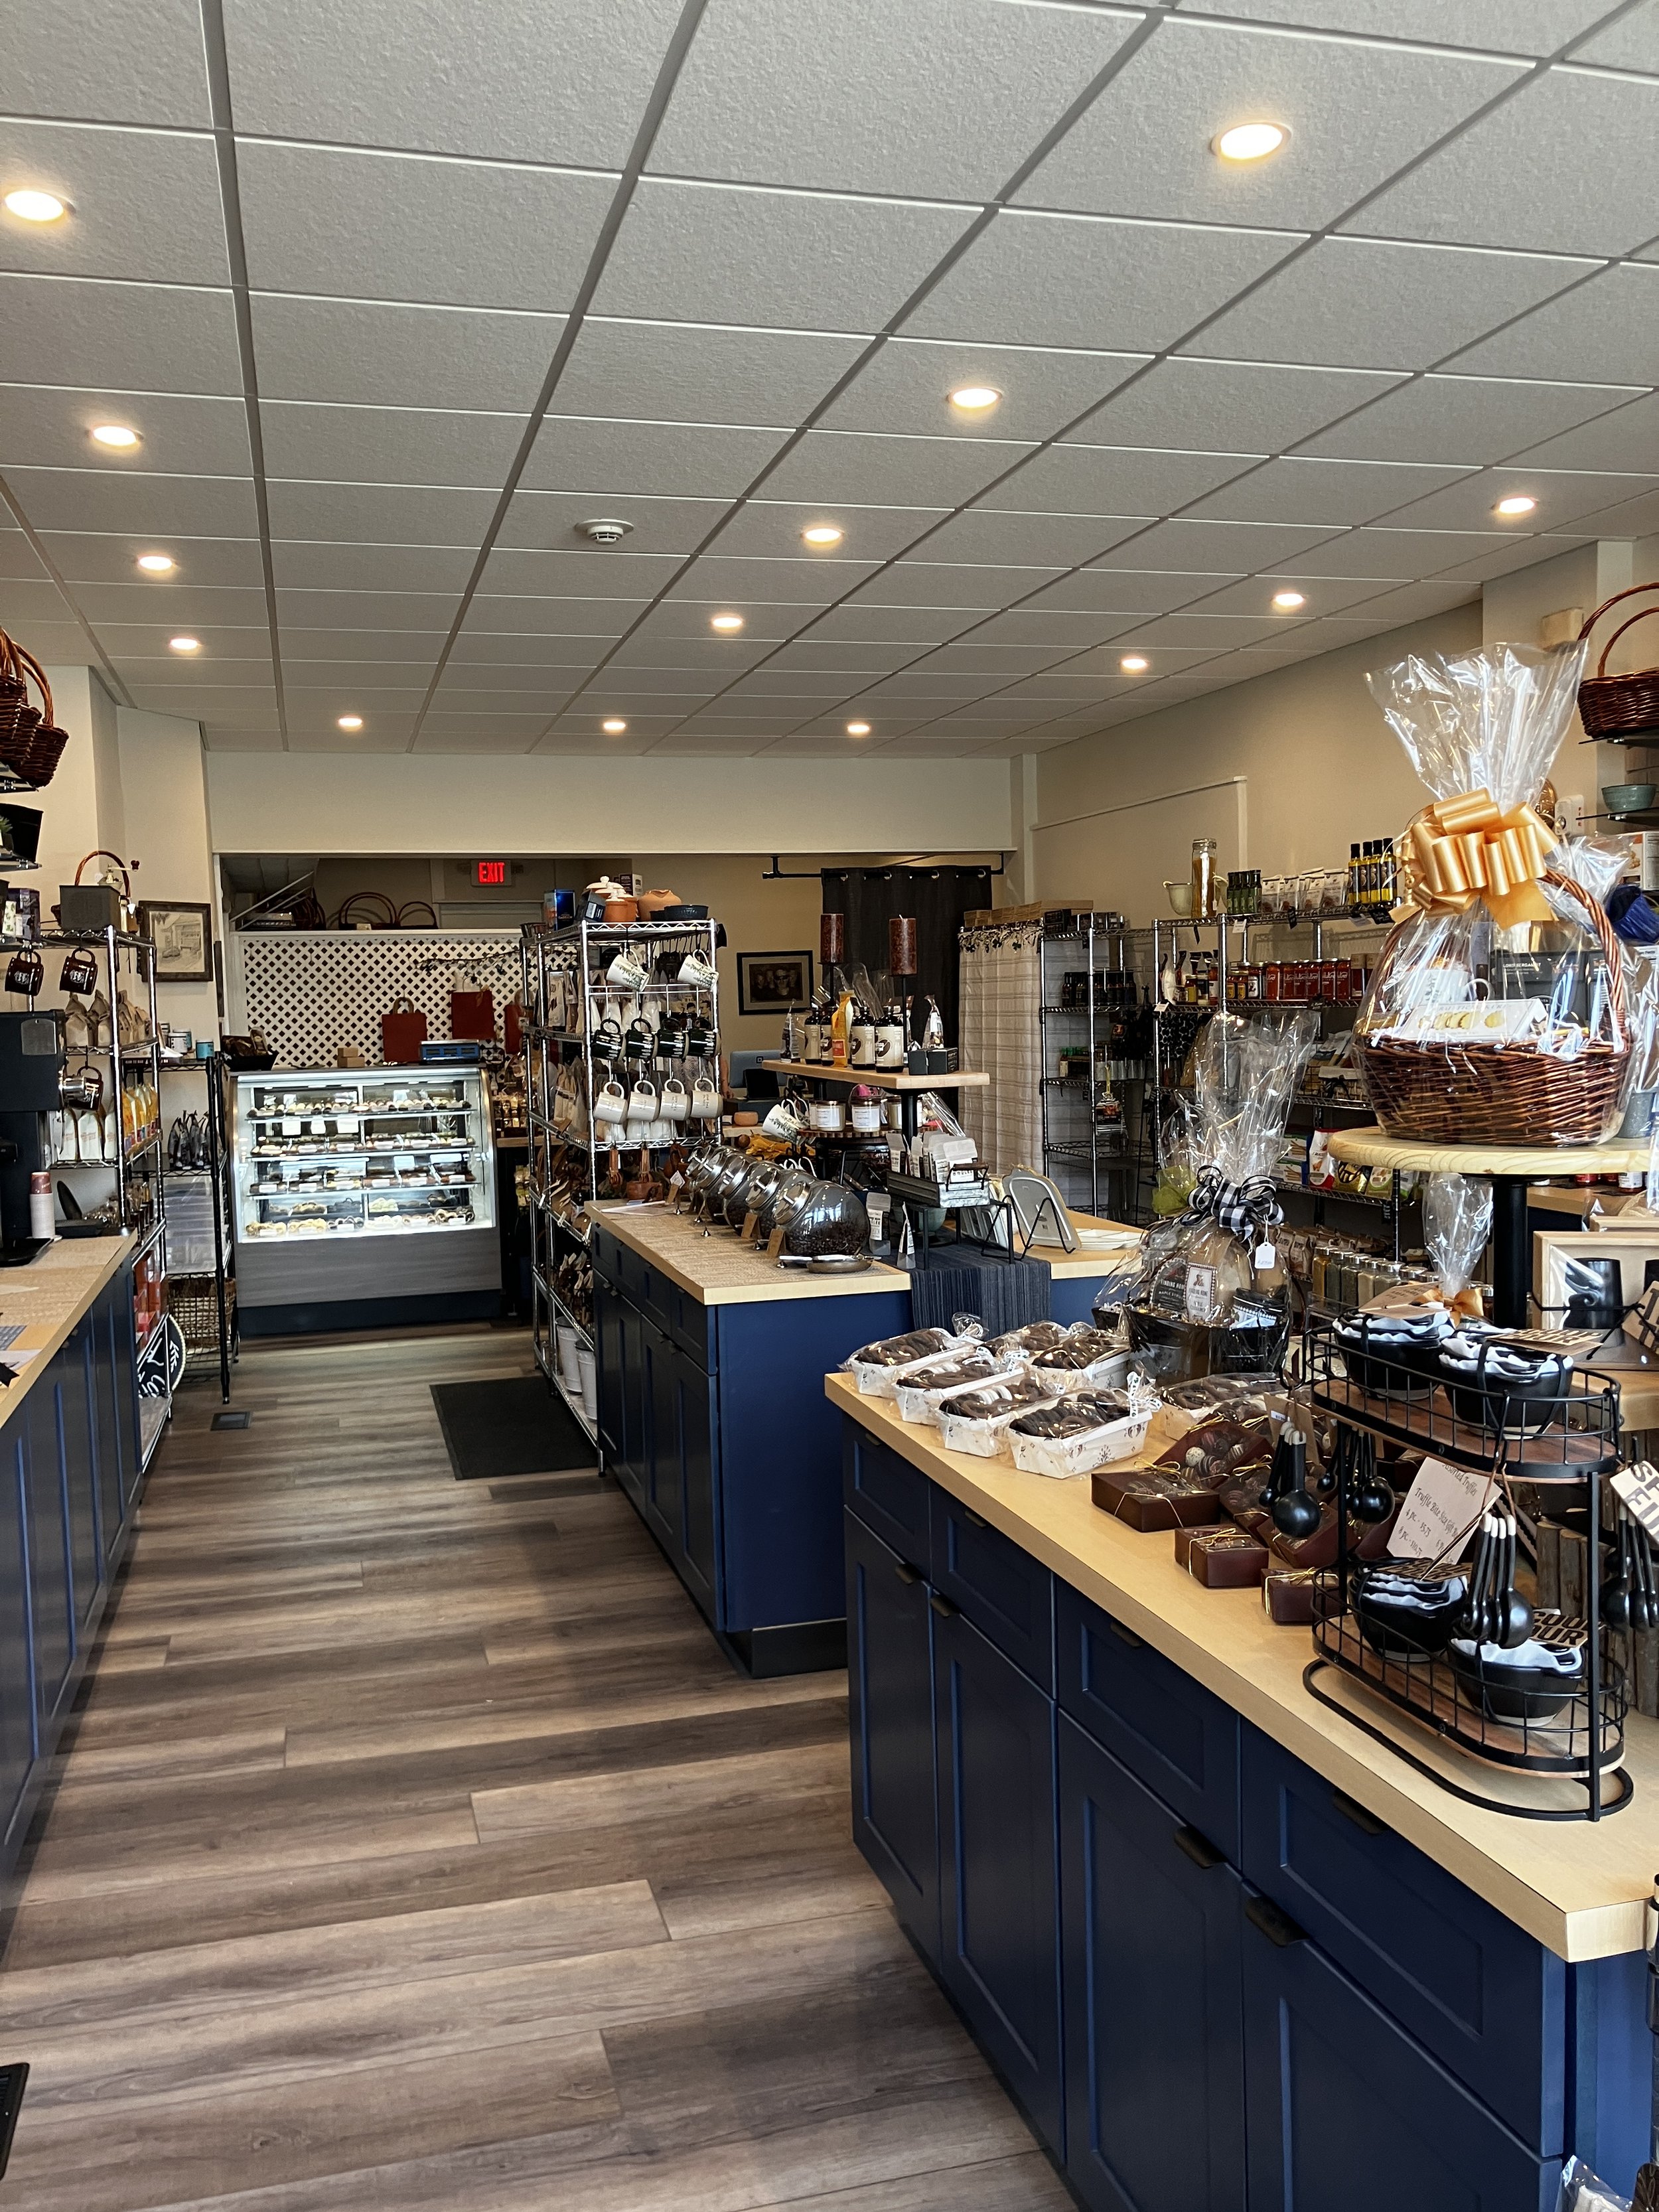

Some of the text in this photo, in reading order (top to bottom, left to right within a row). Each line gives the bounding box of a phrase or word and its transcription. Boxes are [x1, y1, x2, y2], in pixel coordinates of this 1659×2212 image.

[478, 862, 505, 883] EXIT
[1462, 1476, 1478, 1497] Truffles
[1414, 1487, 1431, 1508] Truffle
[1429, 1502, 1440, 1517] Bite
